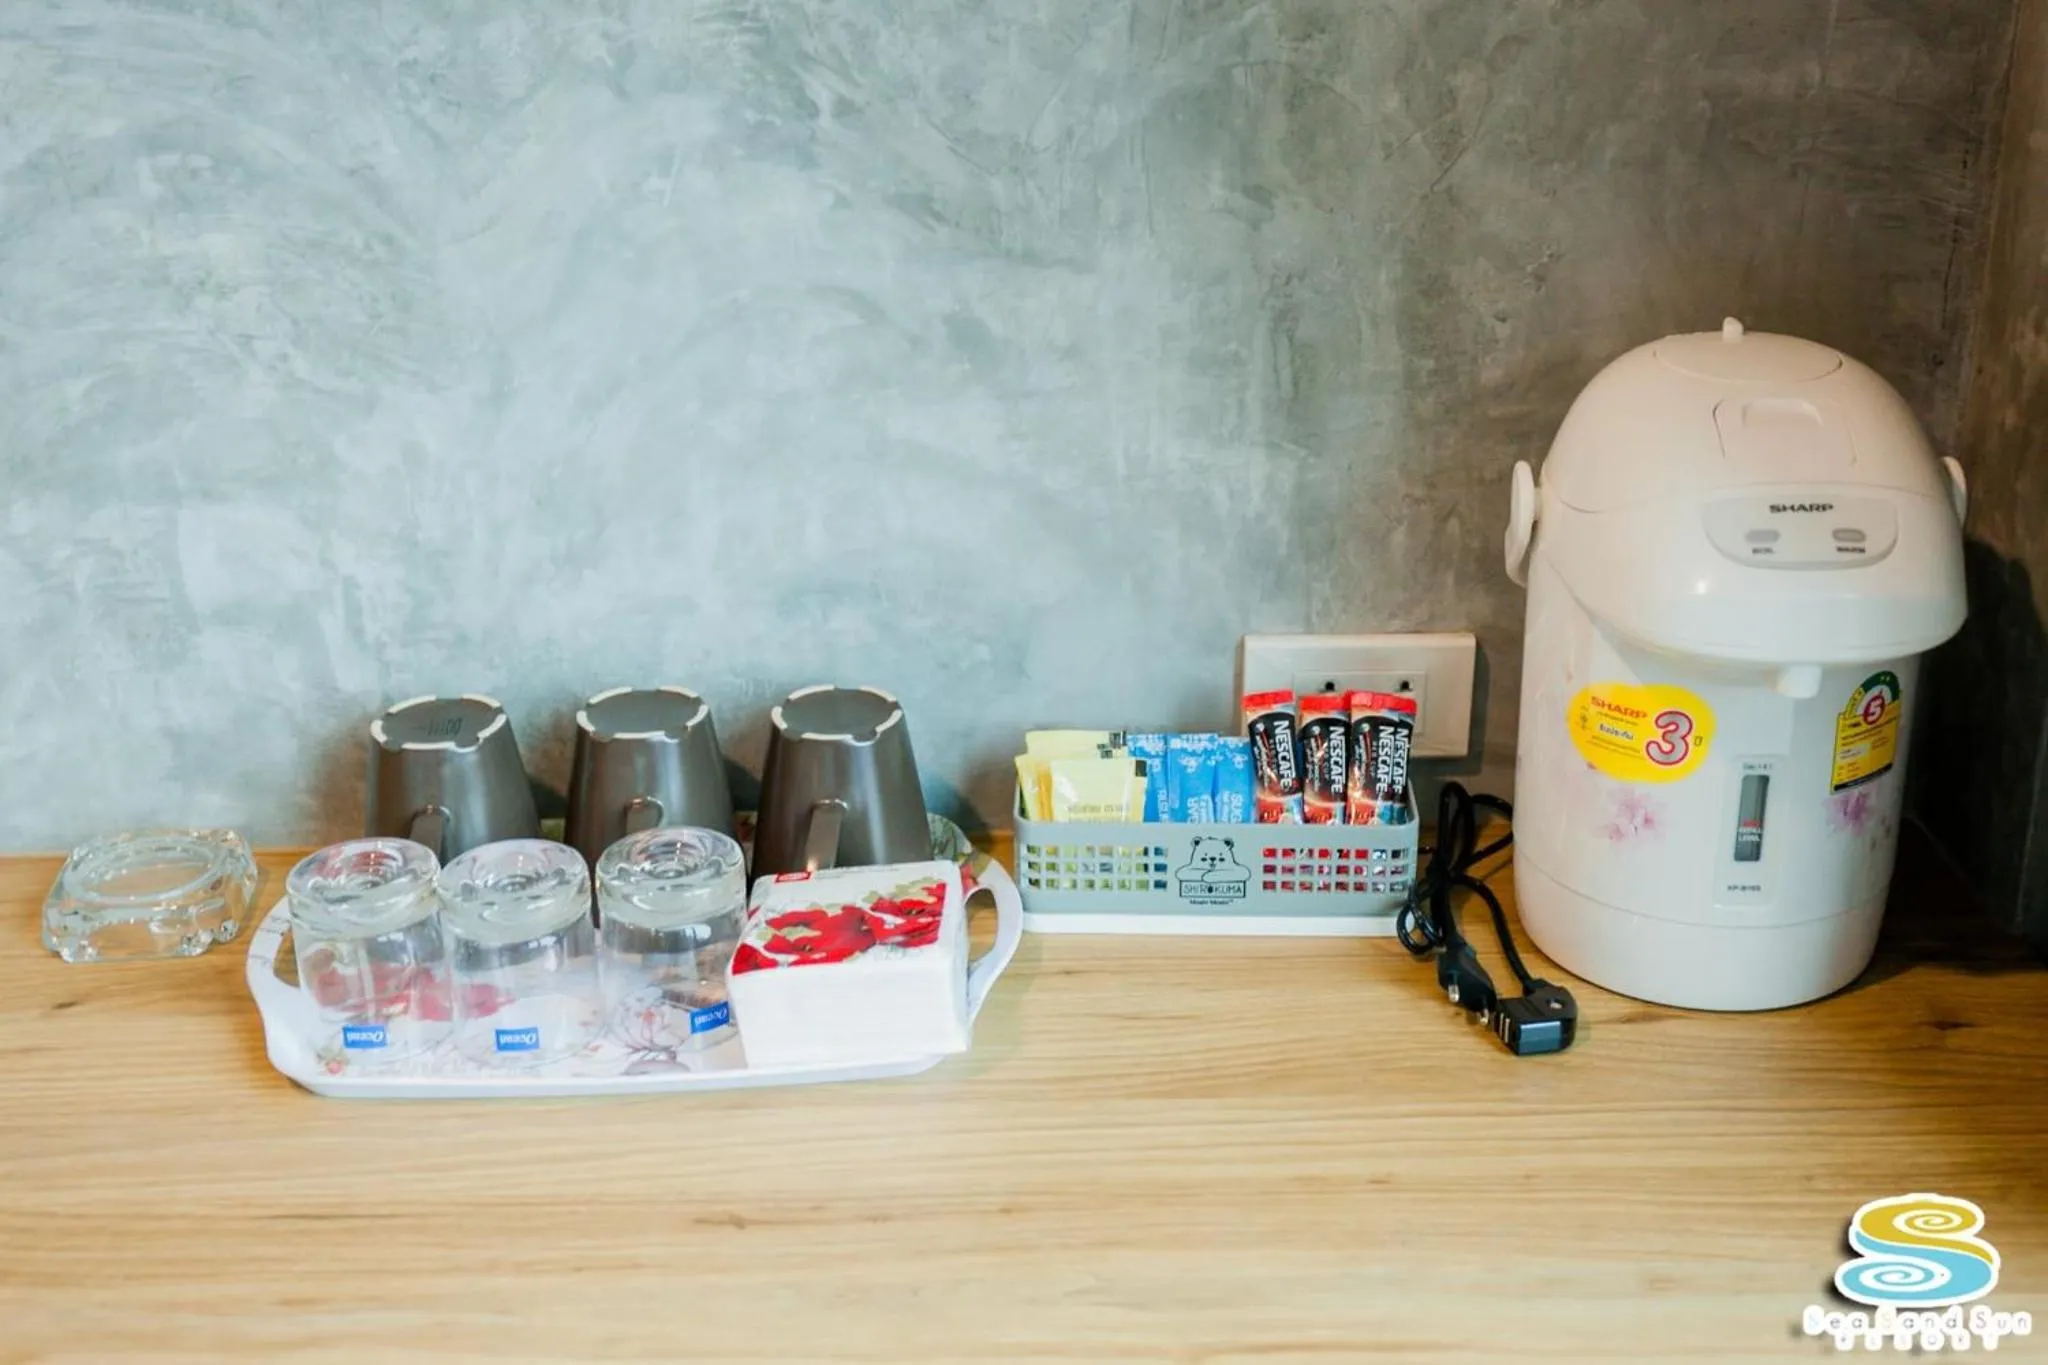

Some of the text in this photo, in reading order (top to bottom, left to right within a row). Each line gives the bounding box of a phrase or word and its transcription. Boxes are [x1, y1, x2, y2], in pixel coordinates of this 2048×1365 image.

[1769, 503, 1833, 514] SHARP
[1591, 696, 1648, 719] SHARP
[1645, 710, 1694, 767] 3
[1183, 883, 1242, 895] SHIROKUMA
[692, 1007, 729, 1030] Ocean
[346, 1030, 384, 1045] Ocean
[498, 1031, 538, 1046] Ocean
